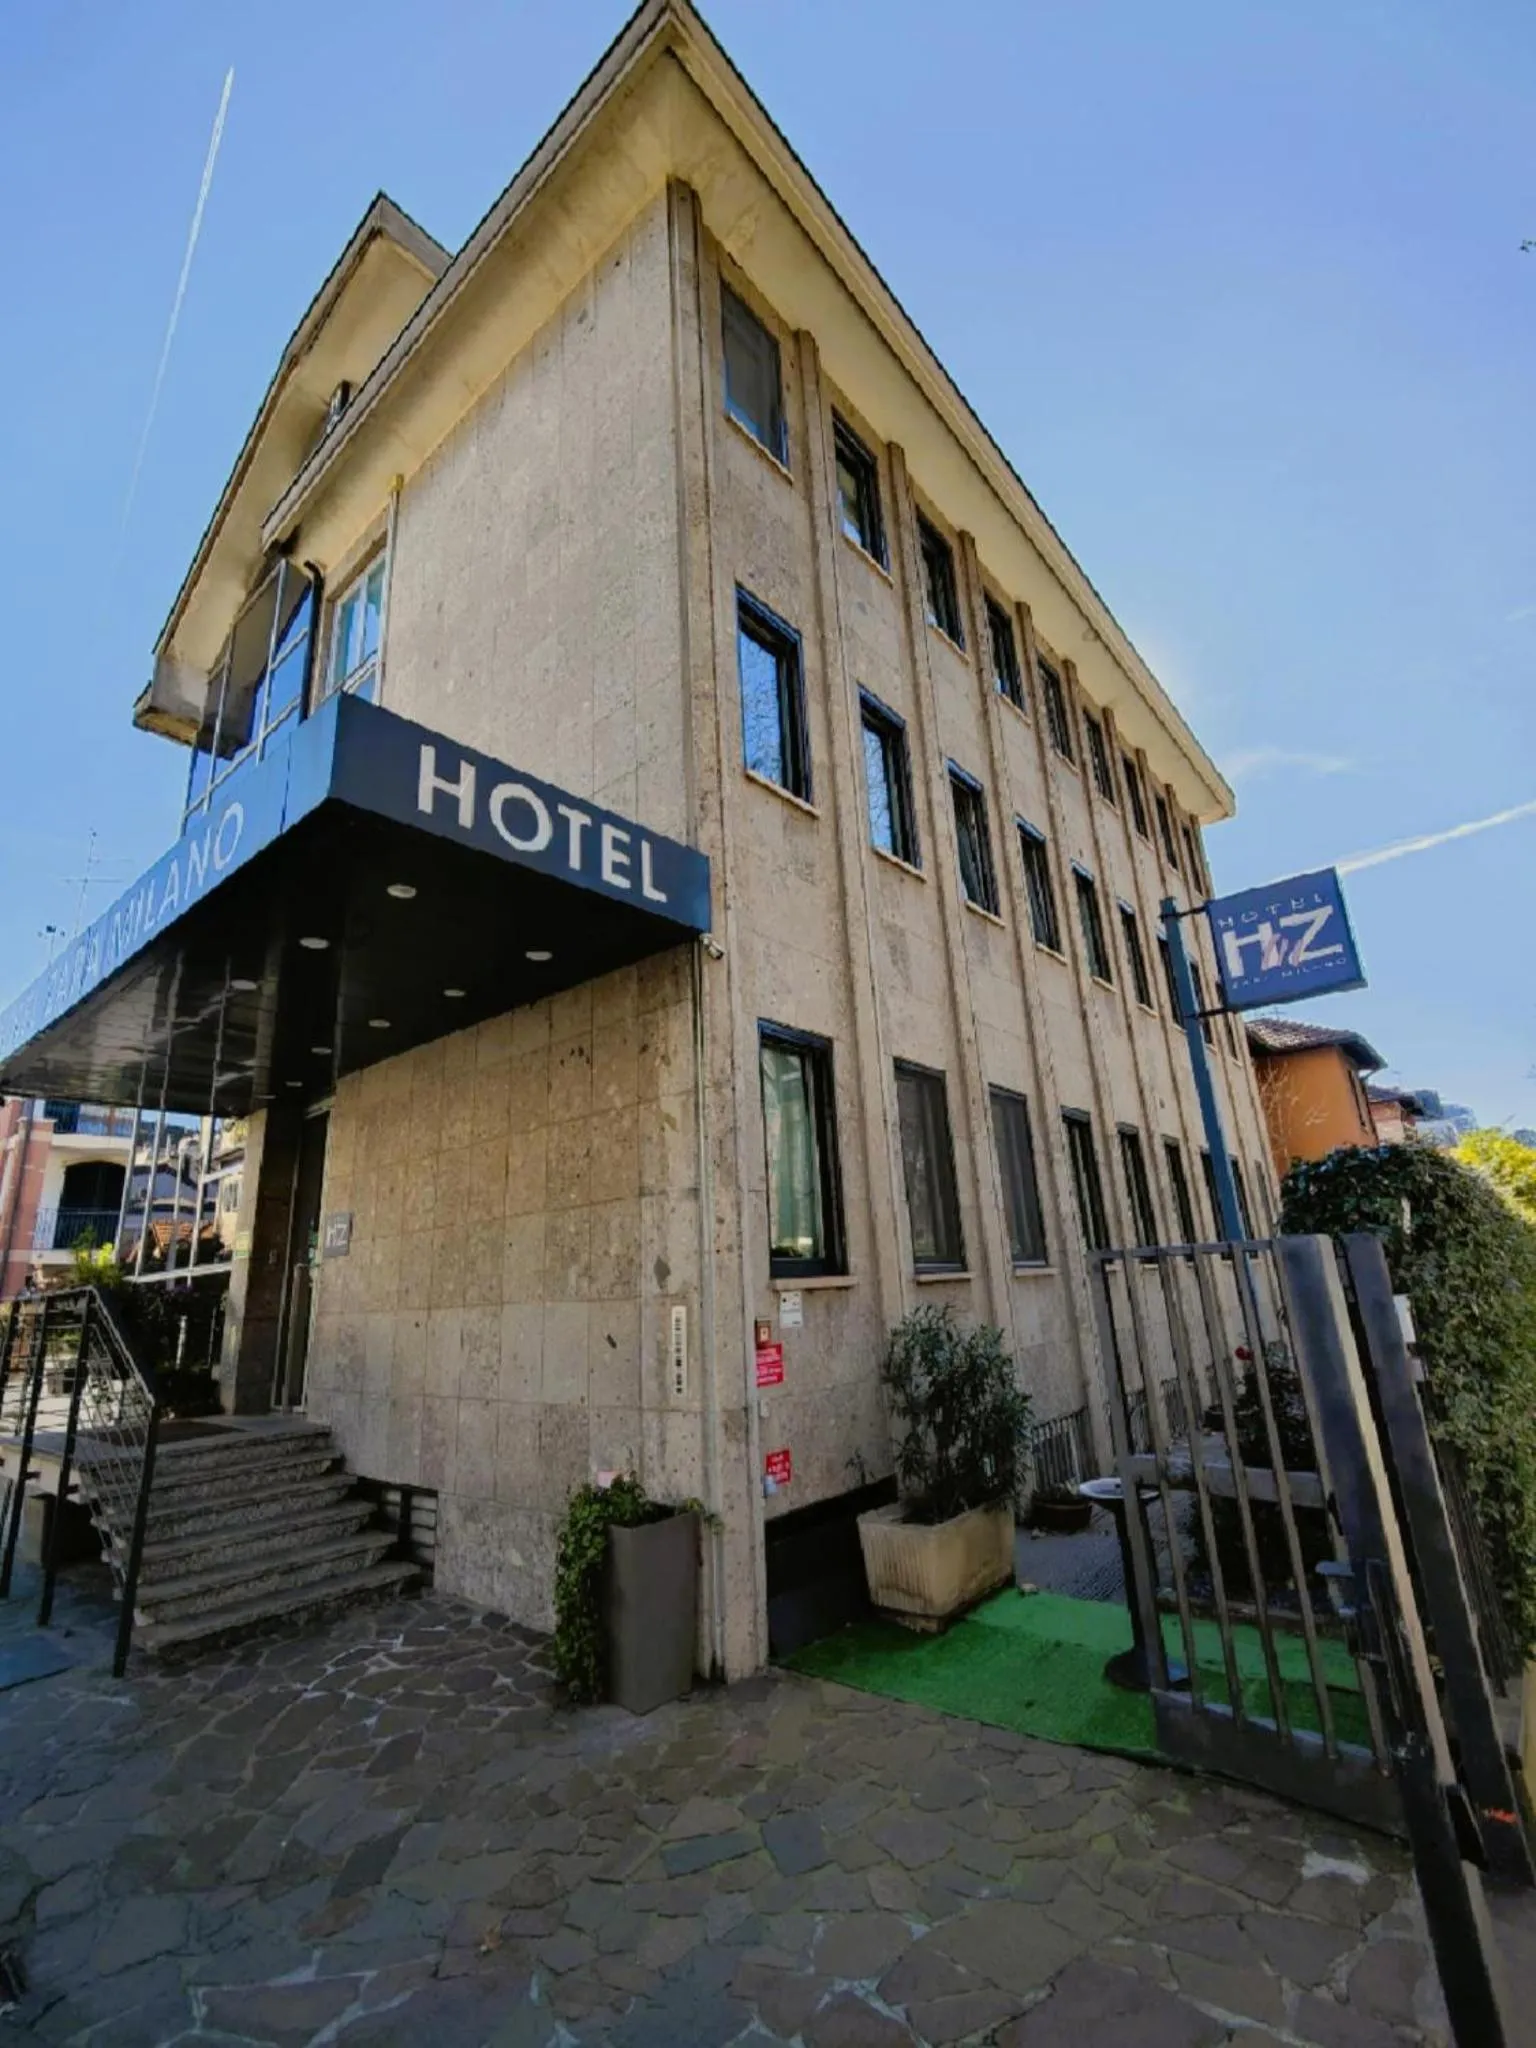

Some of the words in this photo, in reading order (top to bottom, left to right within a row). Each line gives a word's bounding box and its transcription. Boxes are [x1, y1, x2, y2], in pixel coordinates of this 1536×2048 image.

[110, 802, 244, 957] MILANO
[418, 743, 668, 903] HOTEL
[1217, 893, 1323, 929] HOTEL
